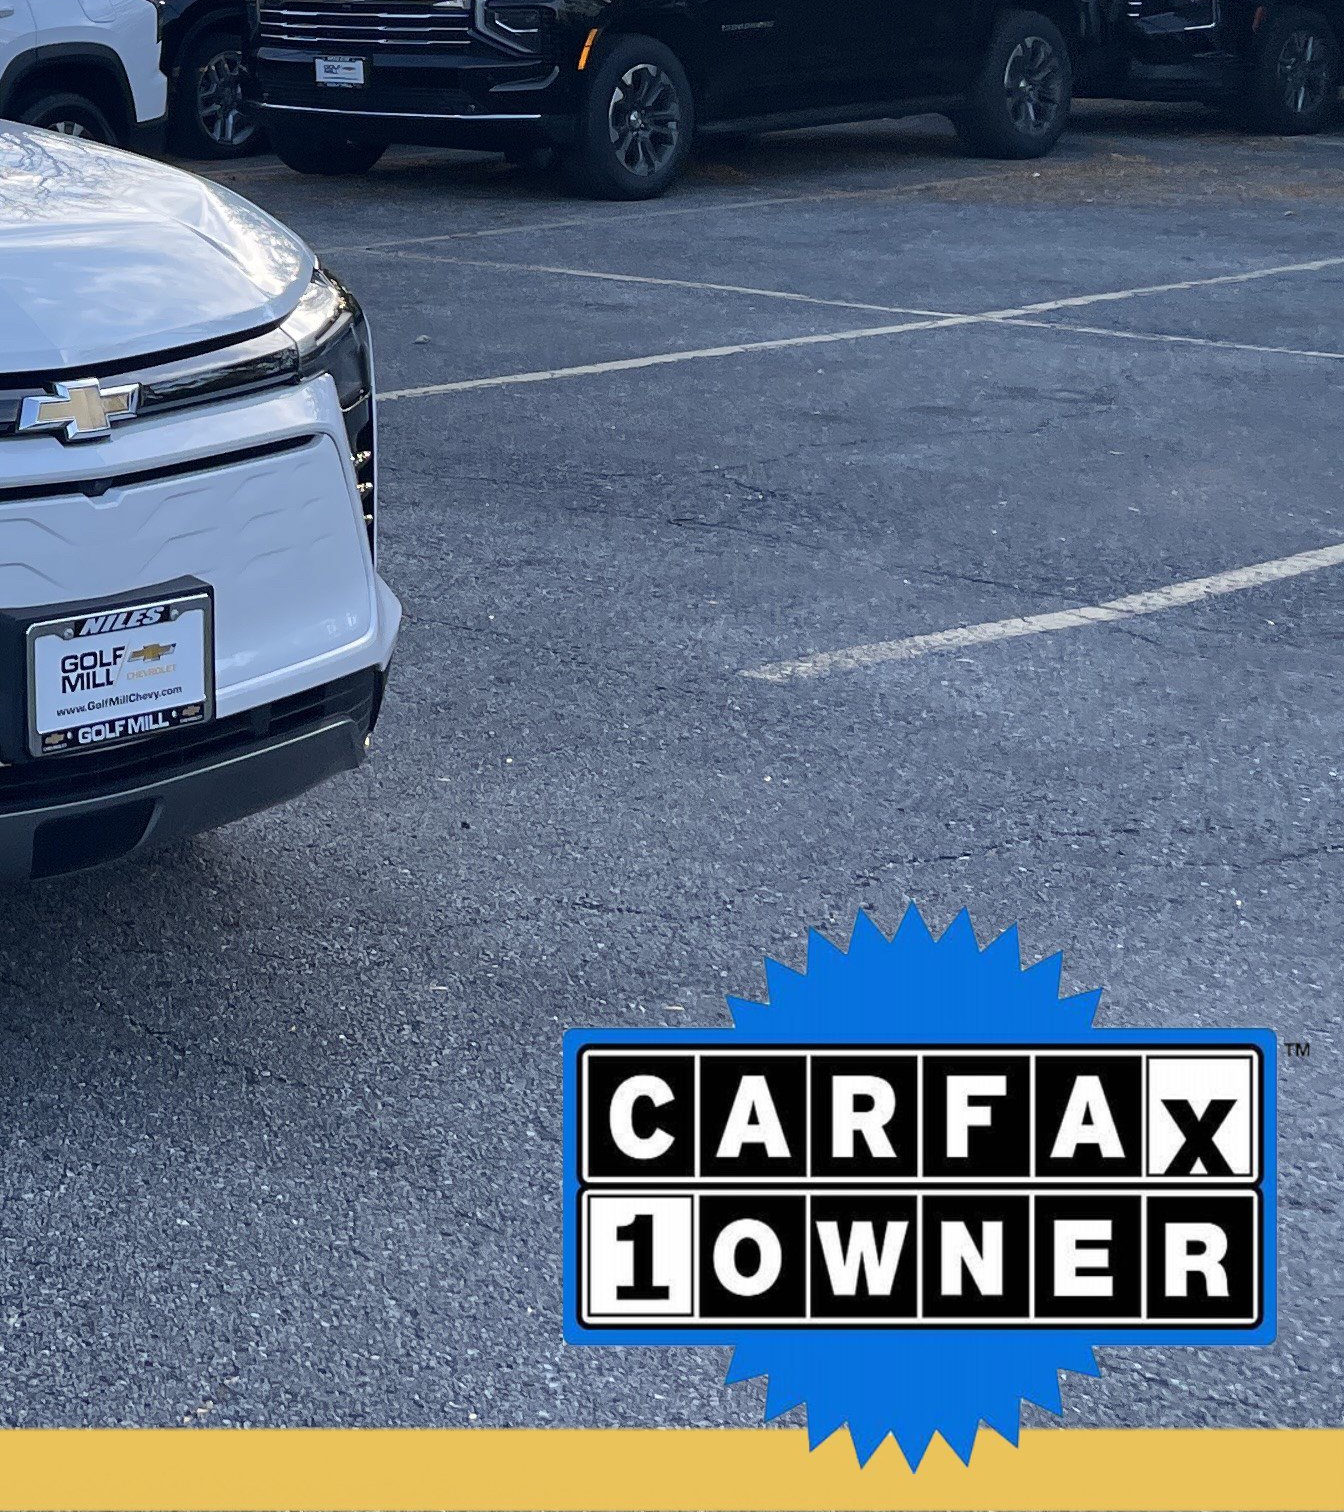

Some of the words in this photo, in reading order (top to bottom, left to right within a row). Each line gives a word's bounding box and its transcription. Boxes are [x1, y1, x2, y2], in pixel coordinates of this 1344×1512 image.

[79, 606, 165, 635] NILES
[61, 646, 125, 674] GOLF
[61, 668, 114, 694] MILL
[56, 686, 183, 716] www.GolfMillChevy.com
[78, 720, 126, 745] GOLF
[127, 712, 169, 735] MILL
